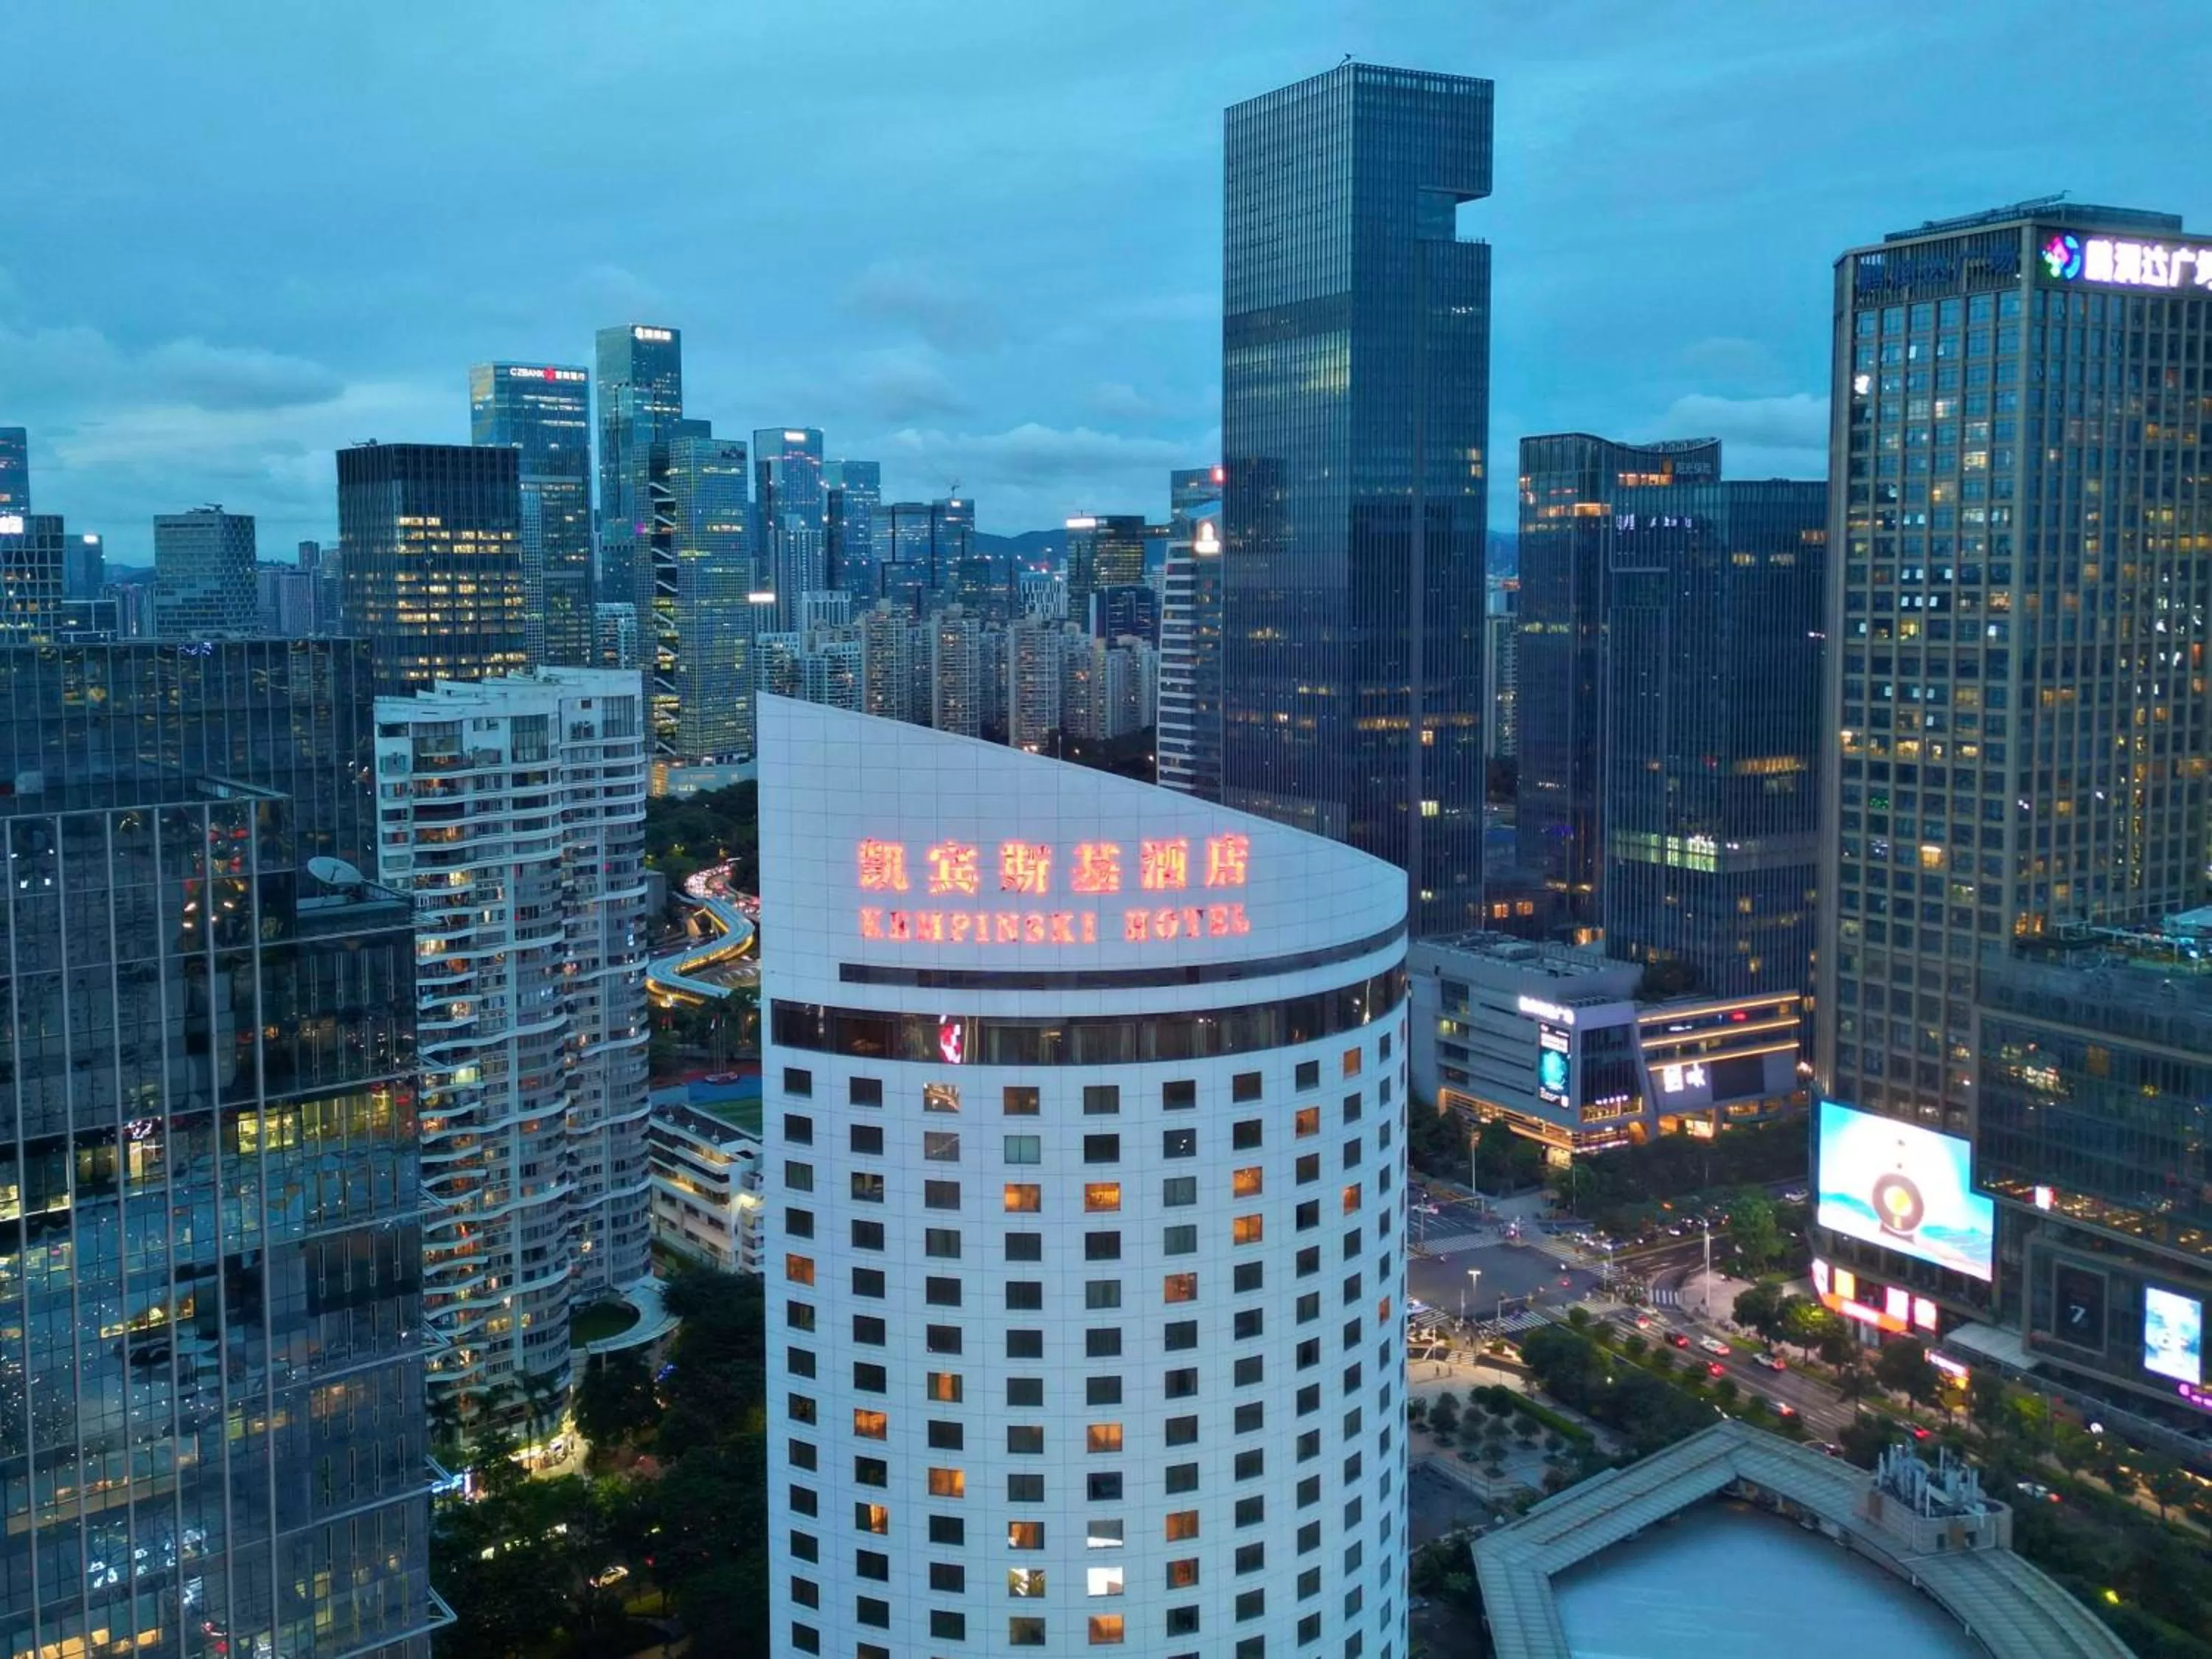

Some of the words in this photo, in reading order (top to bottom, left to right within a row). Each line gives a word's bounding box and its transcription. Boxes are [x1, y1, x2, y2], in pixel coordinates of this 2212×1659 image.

[860, 834, 1249, 894] 凯宾斯基酒店
[860, 907, 1096, 943] KEMPINSKI
[1124, 902, 1251, 942] HOTEL
